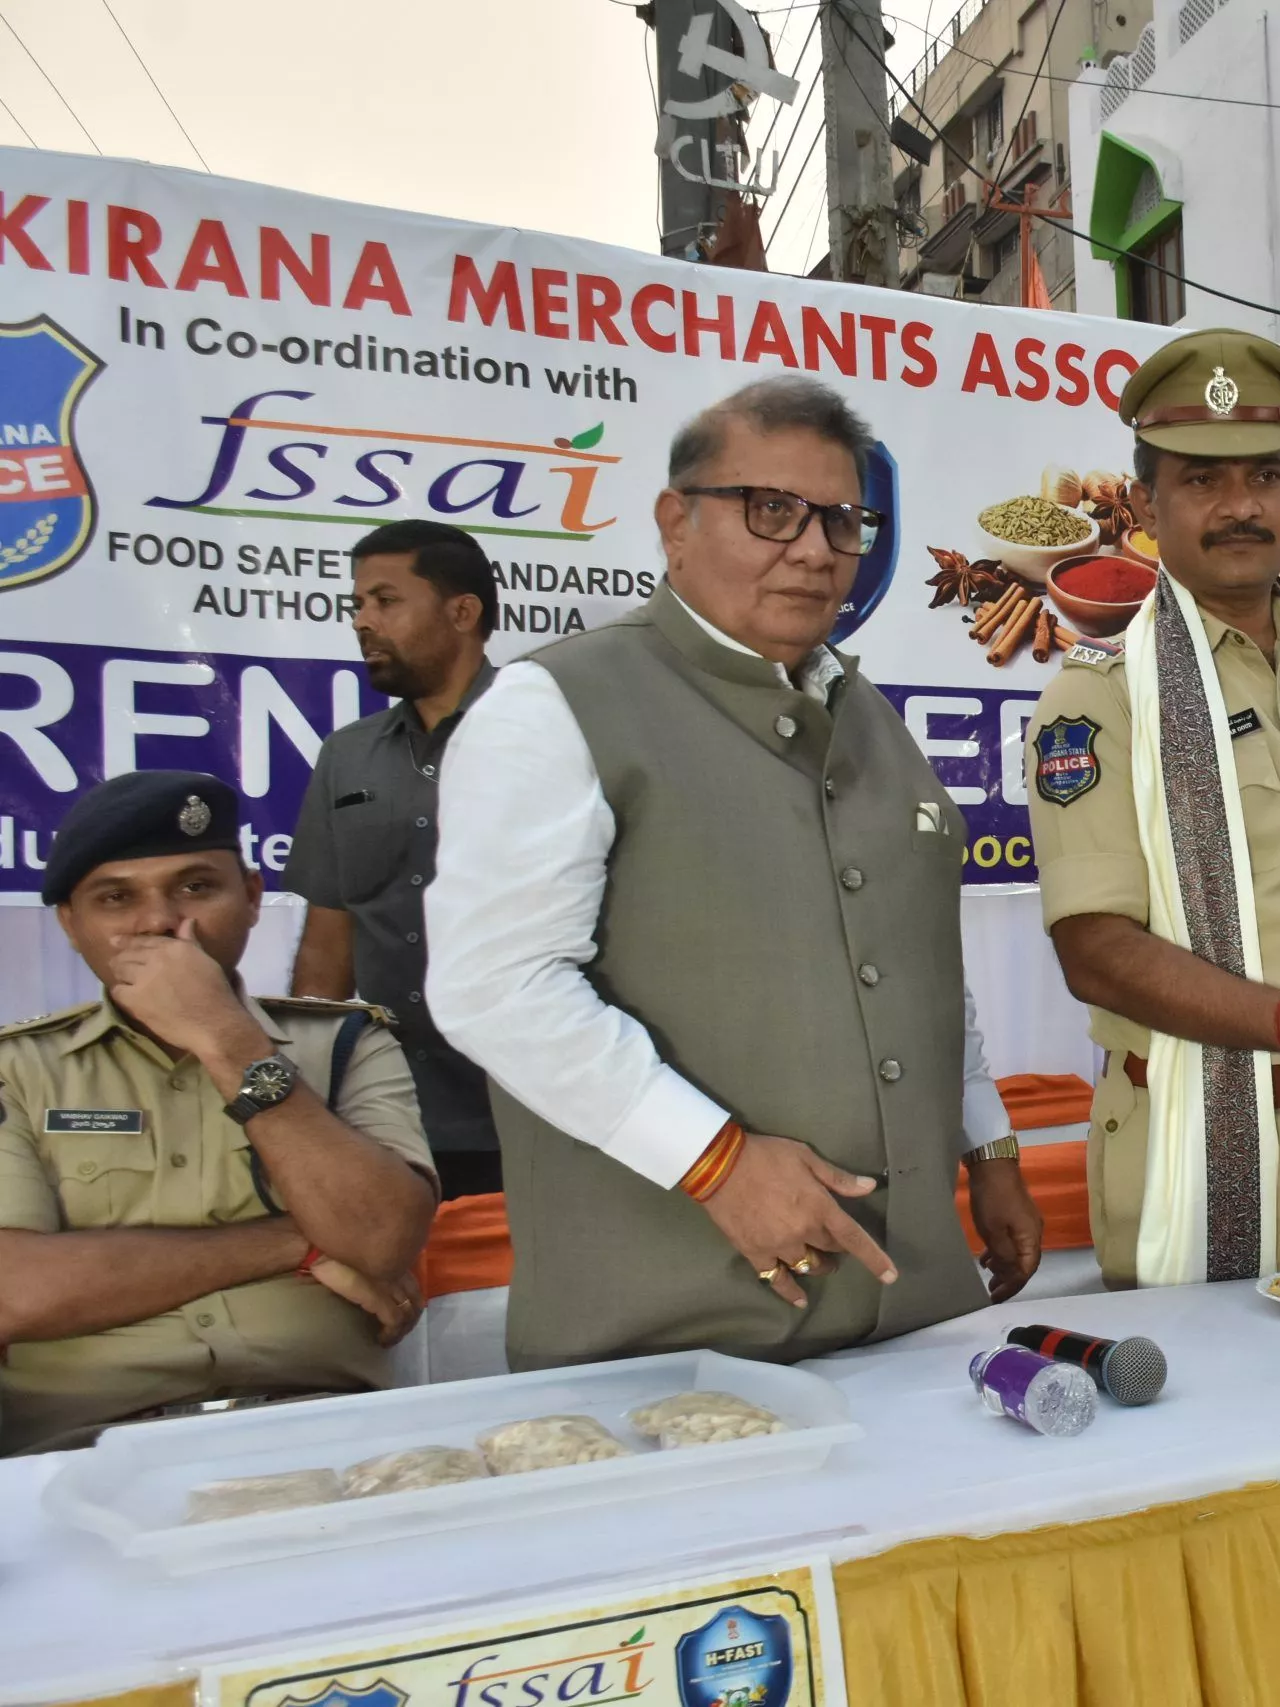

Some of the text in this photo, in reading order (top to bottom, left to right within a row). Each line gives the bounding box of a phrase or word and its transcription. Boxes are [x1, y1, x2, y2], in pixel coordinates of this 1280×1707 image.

[0, 190, 412, 316] KIRANA
[447, 254, 938, 388] MERCHANTS
[120, 306, 638, 402] In Co-ordination with
[143, 390, 622, 534] fssai
[108, 531, 224, 571] FOOD
[1068, 644, 1107, 665] TSP
[1042, 757, 1090, 774] POLICE
[705, 1643, 764, 1668] H-FAST
